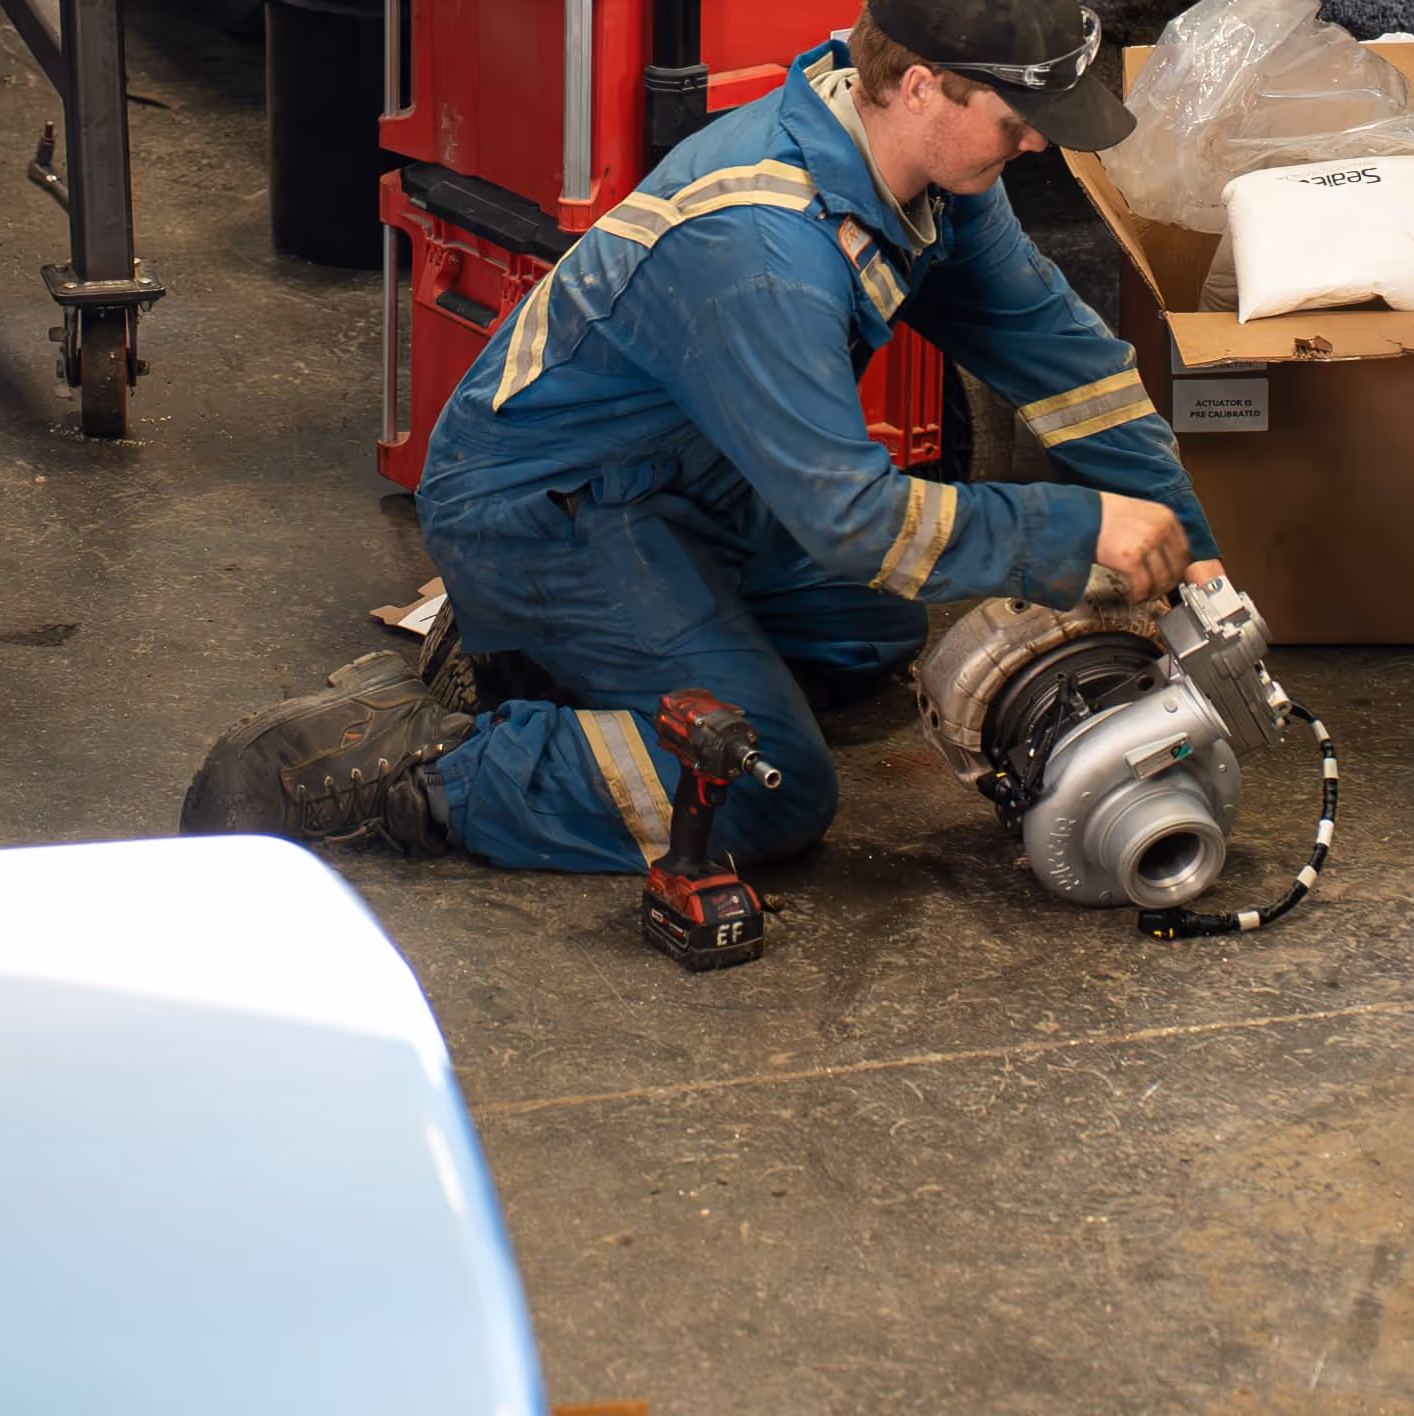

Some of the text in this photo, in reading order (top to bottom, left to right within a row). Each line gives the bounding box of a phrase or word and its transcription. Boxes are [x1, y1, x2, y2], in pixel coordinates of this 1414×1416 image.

[1195, 399, 1243, 407] ACTUATOR
[1190, 409, 1261, 418] PRE CALIBRATED
